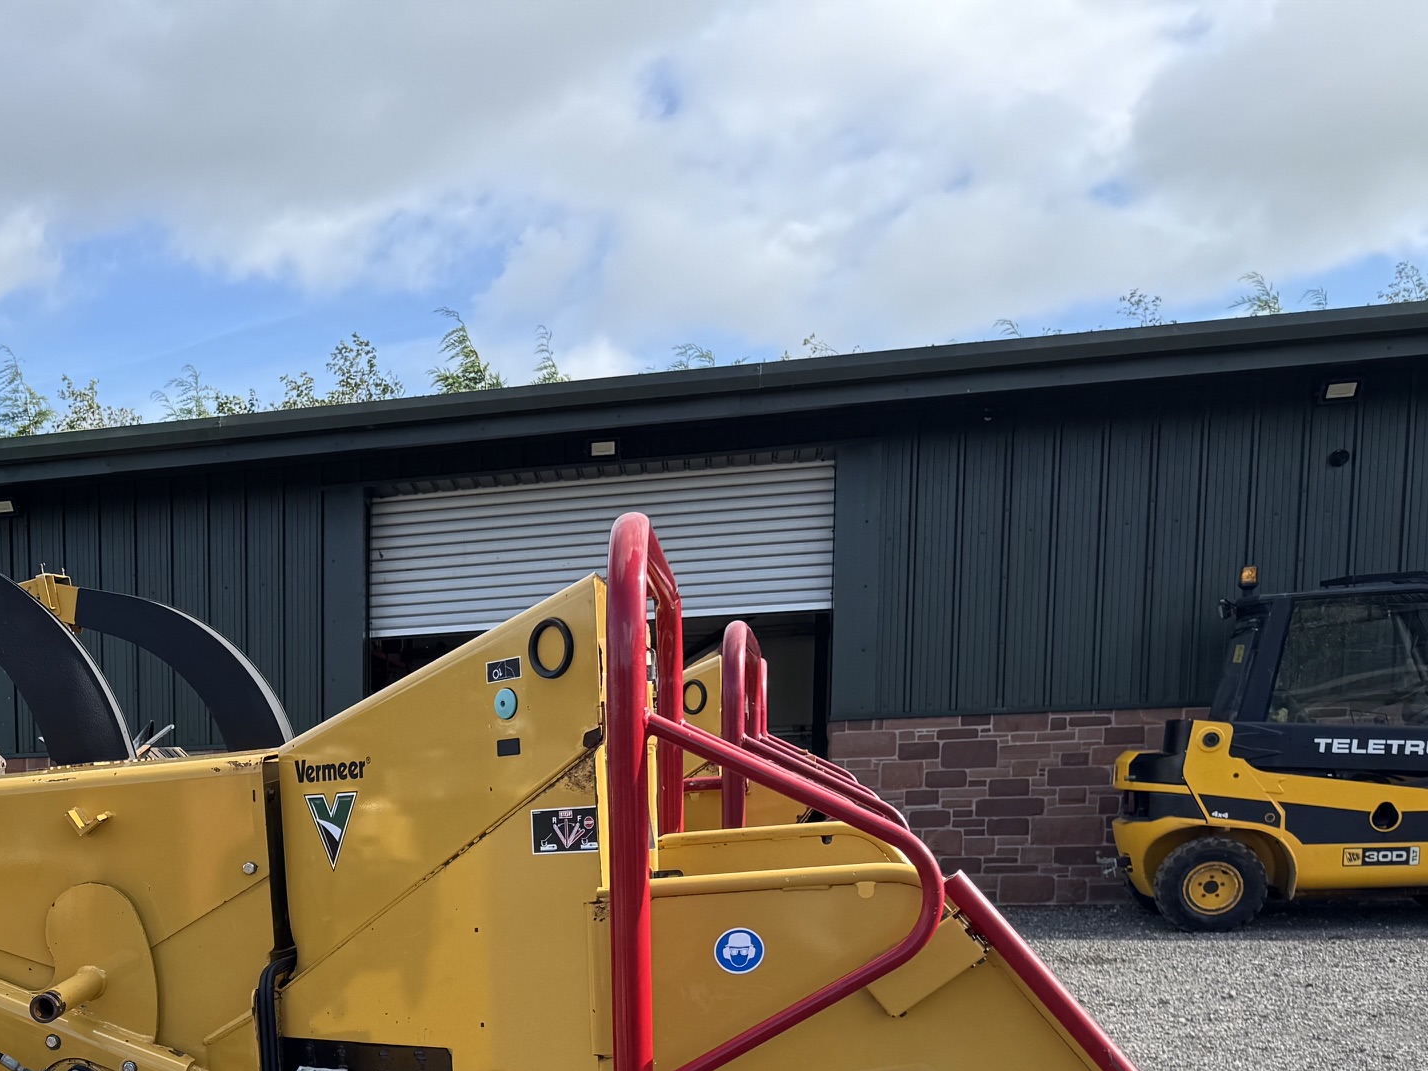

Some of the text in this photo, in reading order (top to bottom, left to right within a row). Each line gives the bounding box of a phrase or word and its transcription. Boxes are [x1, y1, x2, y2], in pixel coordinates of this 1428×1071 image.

[1314, 738, 1428, 755] TELETR
[294, 759, 366, 784] Vermeer
[1364, 850, 1407, 862] 30D
